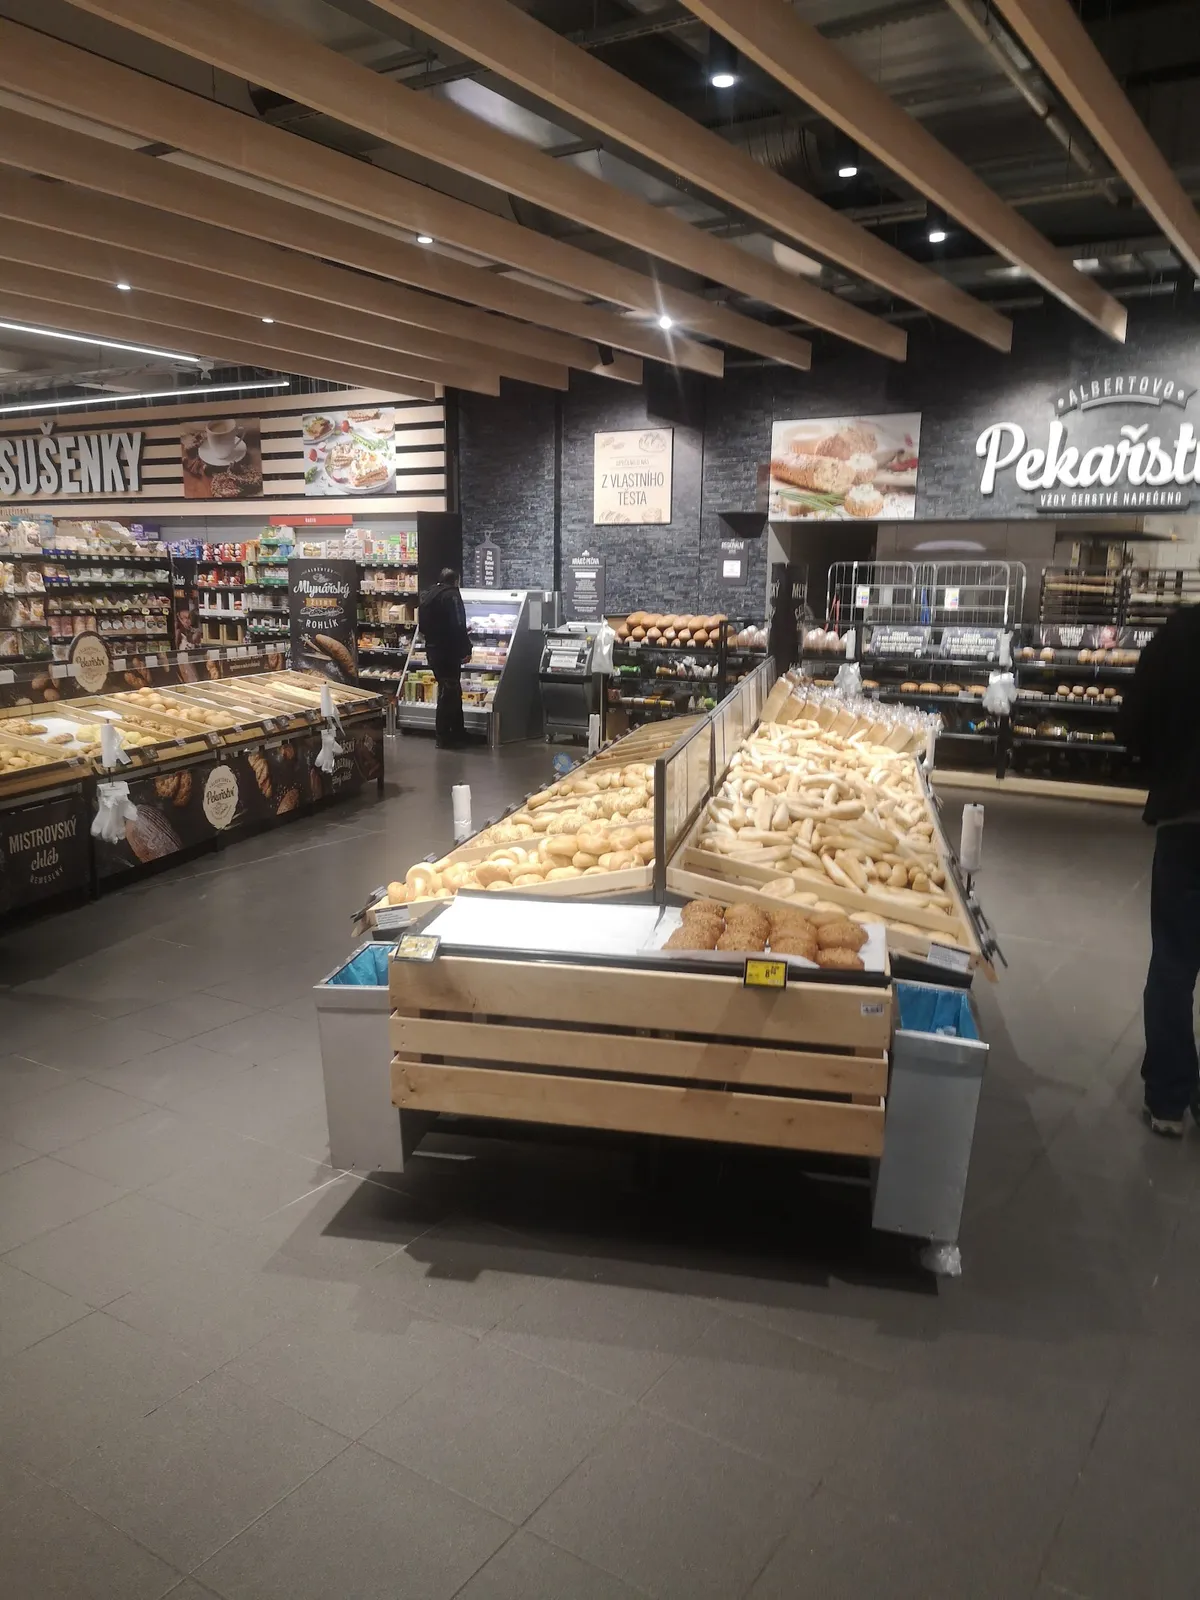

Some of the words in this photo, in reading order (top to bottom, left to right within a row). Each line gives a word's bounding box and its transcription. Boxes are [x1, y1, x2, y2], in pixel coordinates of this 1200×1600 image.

[1069, 376, 1174, 407] ALBERTOVO
[0, 421, 142, 495] SUŠENKY
[975, 420, 1200, 495] Pekařst
[602, 474, 608, 489] Z
[610, 469, 665, 488] VLASTNÍHO
[617, 488, 648, 506] TĚSTA
[1040, 493, 1066, 507] VŽDY
[1071, 490, 1119, 507] ČERSTVÉ
[1123, 490, 1182, 506] NAPEČENO
[293, 580, 350, 599] Mlynářský
[305, 618, 339, 629] ROHLÍK
[8, 814, 77, 855] MISTROVSKÝ
[31, 846, 60, 871] chléb
